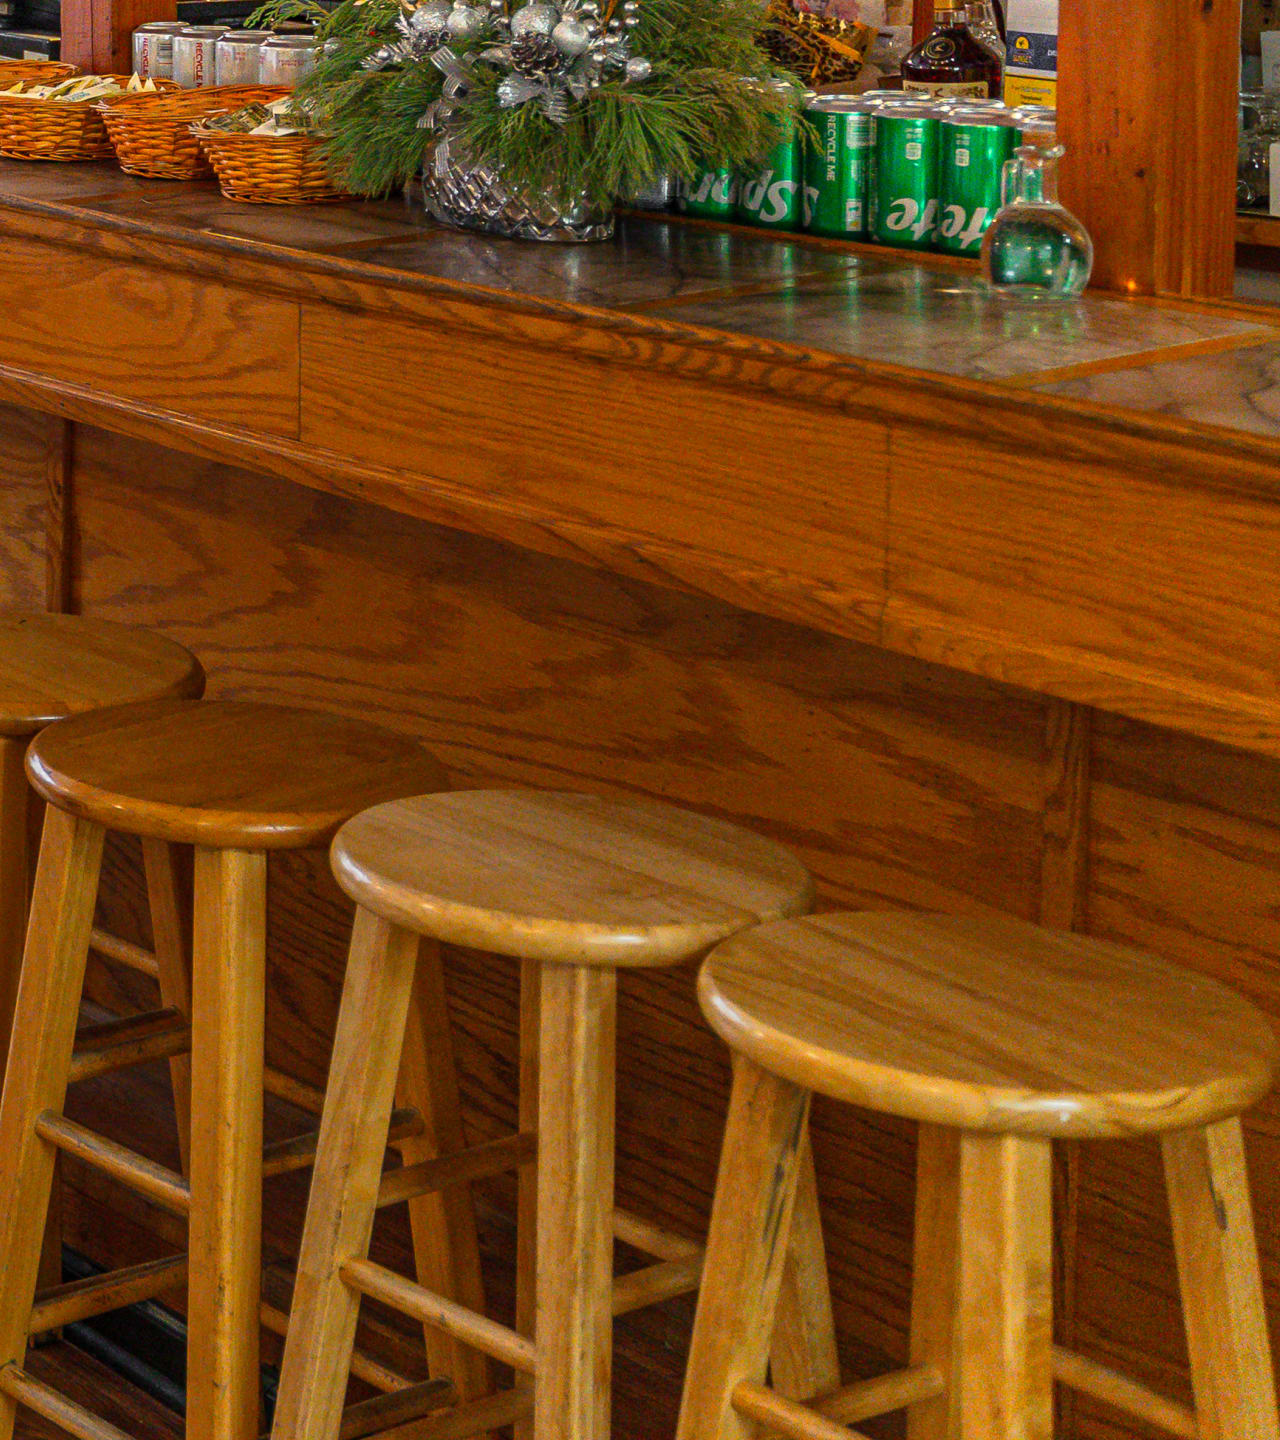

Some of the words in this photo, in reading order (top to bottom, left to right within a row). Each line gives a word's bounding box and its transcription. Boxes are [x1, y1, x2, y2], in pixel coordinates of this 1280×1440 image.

[195, 42, 204, 82] RECYCLE
[826, 115, 837, 163] RECYCLE
[826, 165, 837, 182] ME
